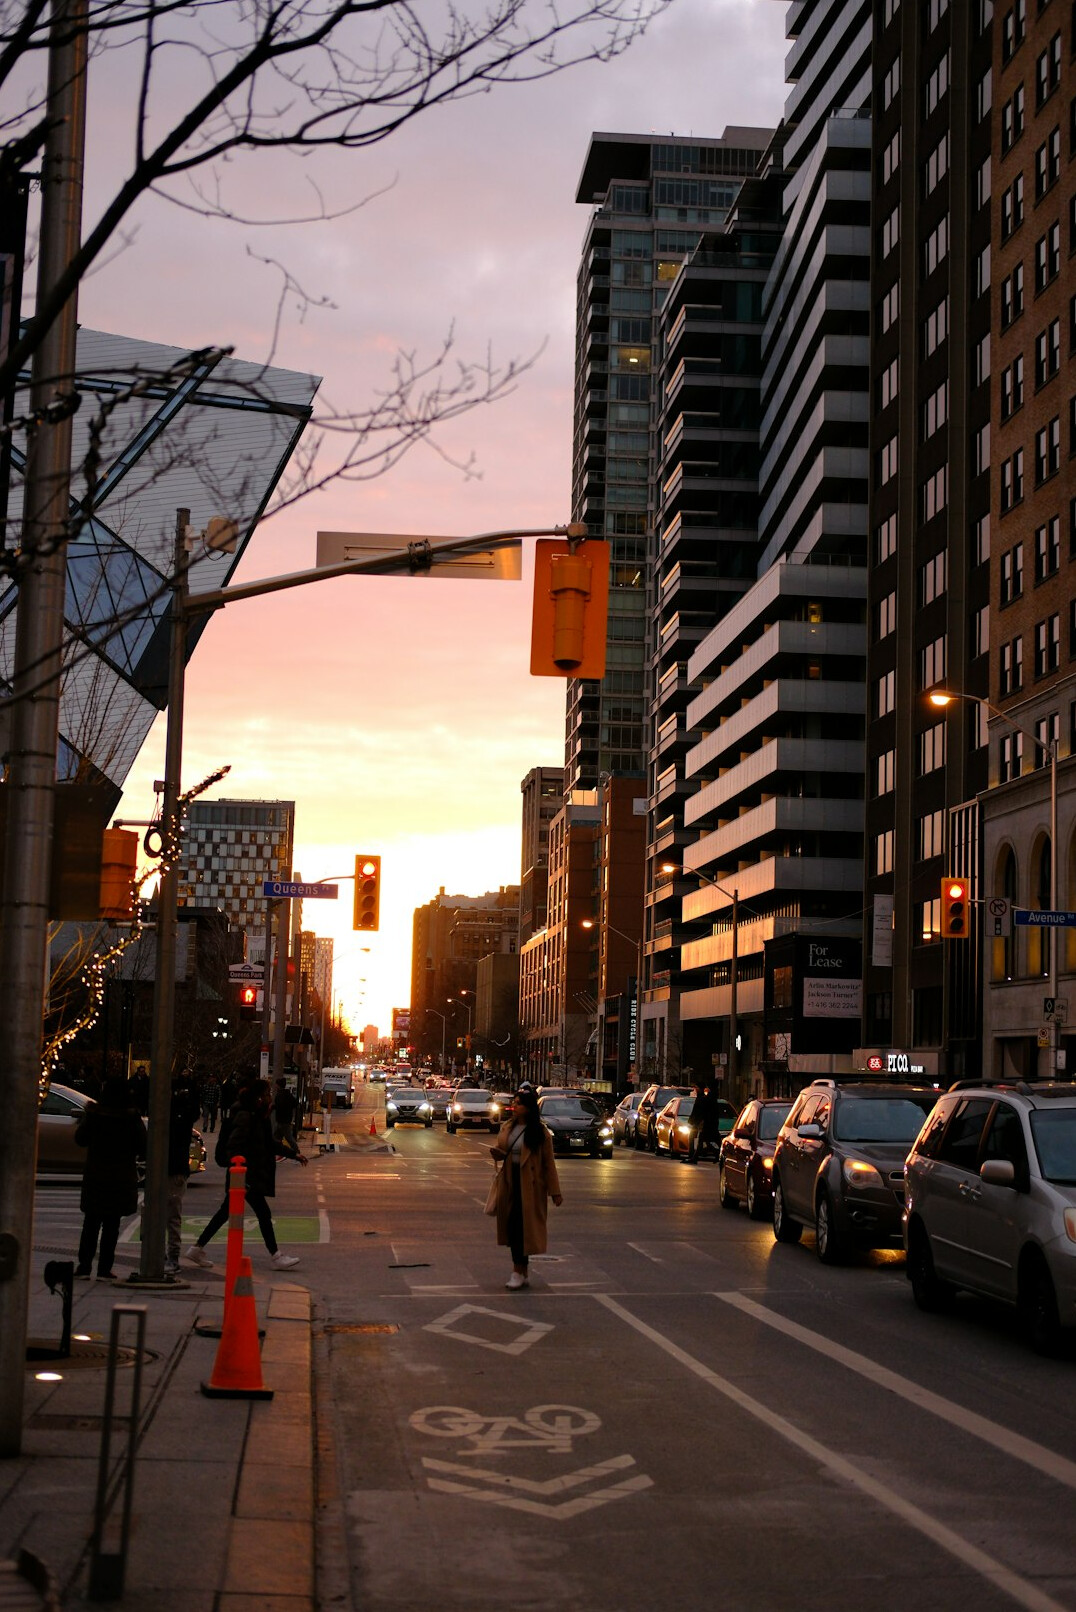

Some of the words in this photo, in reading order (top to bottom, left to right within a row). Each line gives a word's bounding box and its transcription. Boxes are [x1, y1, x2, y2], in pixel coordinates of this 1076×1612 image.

[273, 883, 318, 894] Queens
[1028, 912, 1065, 923] Avenue
[808, 944, 828, 955] For
[808, 956, 842, 967] Lease
